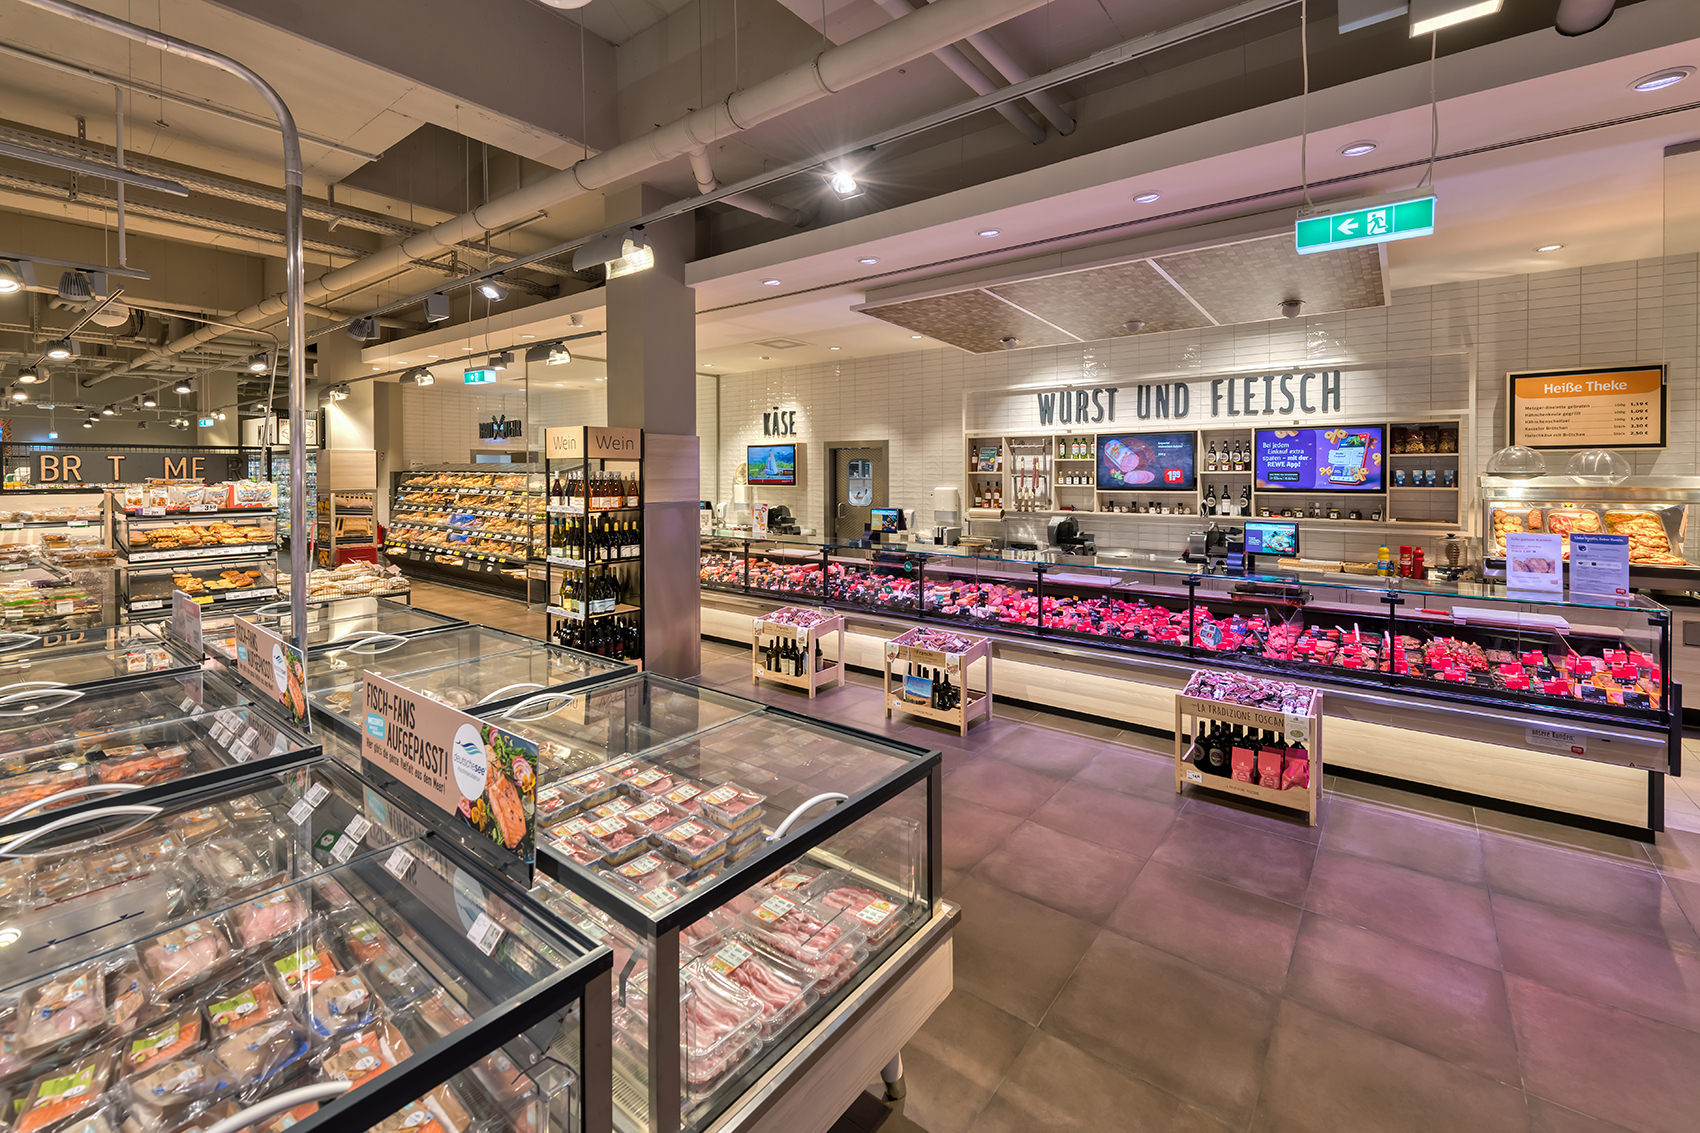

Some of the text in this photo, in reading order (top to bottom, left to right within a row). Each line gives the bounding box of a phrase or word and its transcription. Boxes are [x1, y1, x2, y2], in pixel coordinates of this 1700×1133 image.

[1037, 370, 1342, 426] WURST UND FLEISCH
[1543, 379, 1628, 394] Heiße Theke
[763, 406, 797, 436] KÄSE
[552, 436, 577, 451] Wein
[595, 435, 634, 451] Wein
[366, 682, 416, 730] FISCH-FANS
[1196, 703, 1285, 727] LA TRADIZIONE TOSCAN
[386, 722, 449, 781] AUFGEPASST!
[400, 758, 414, 776] Vielfalt
[423, 772, 432, 786] dem
[433, 777, 446, 795] Meer!
